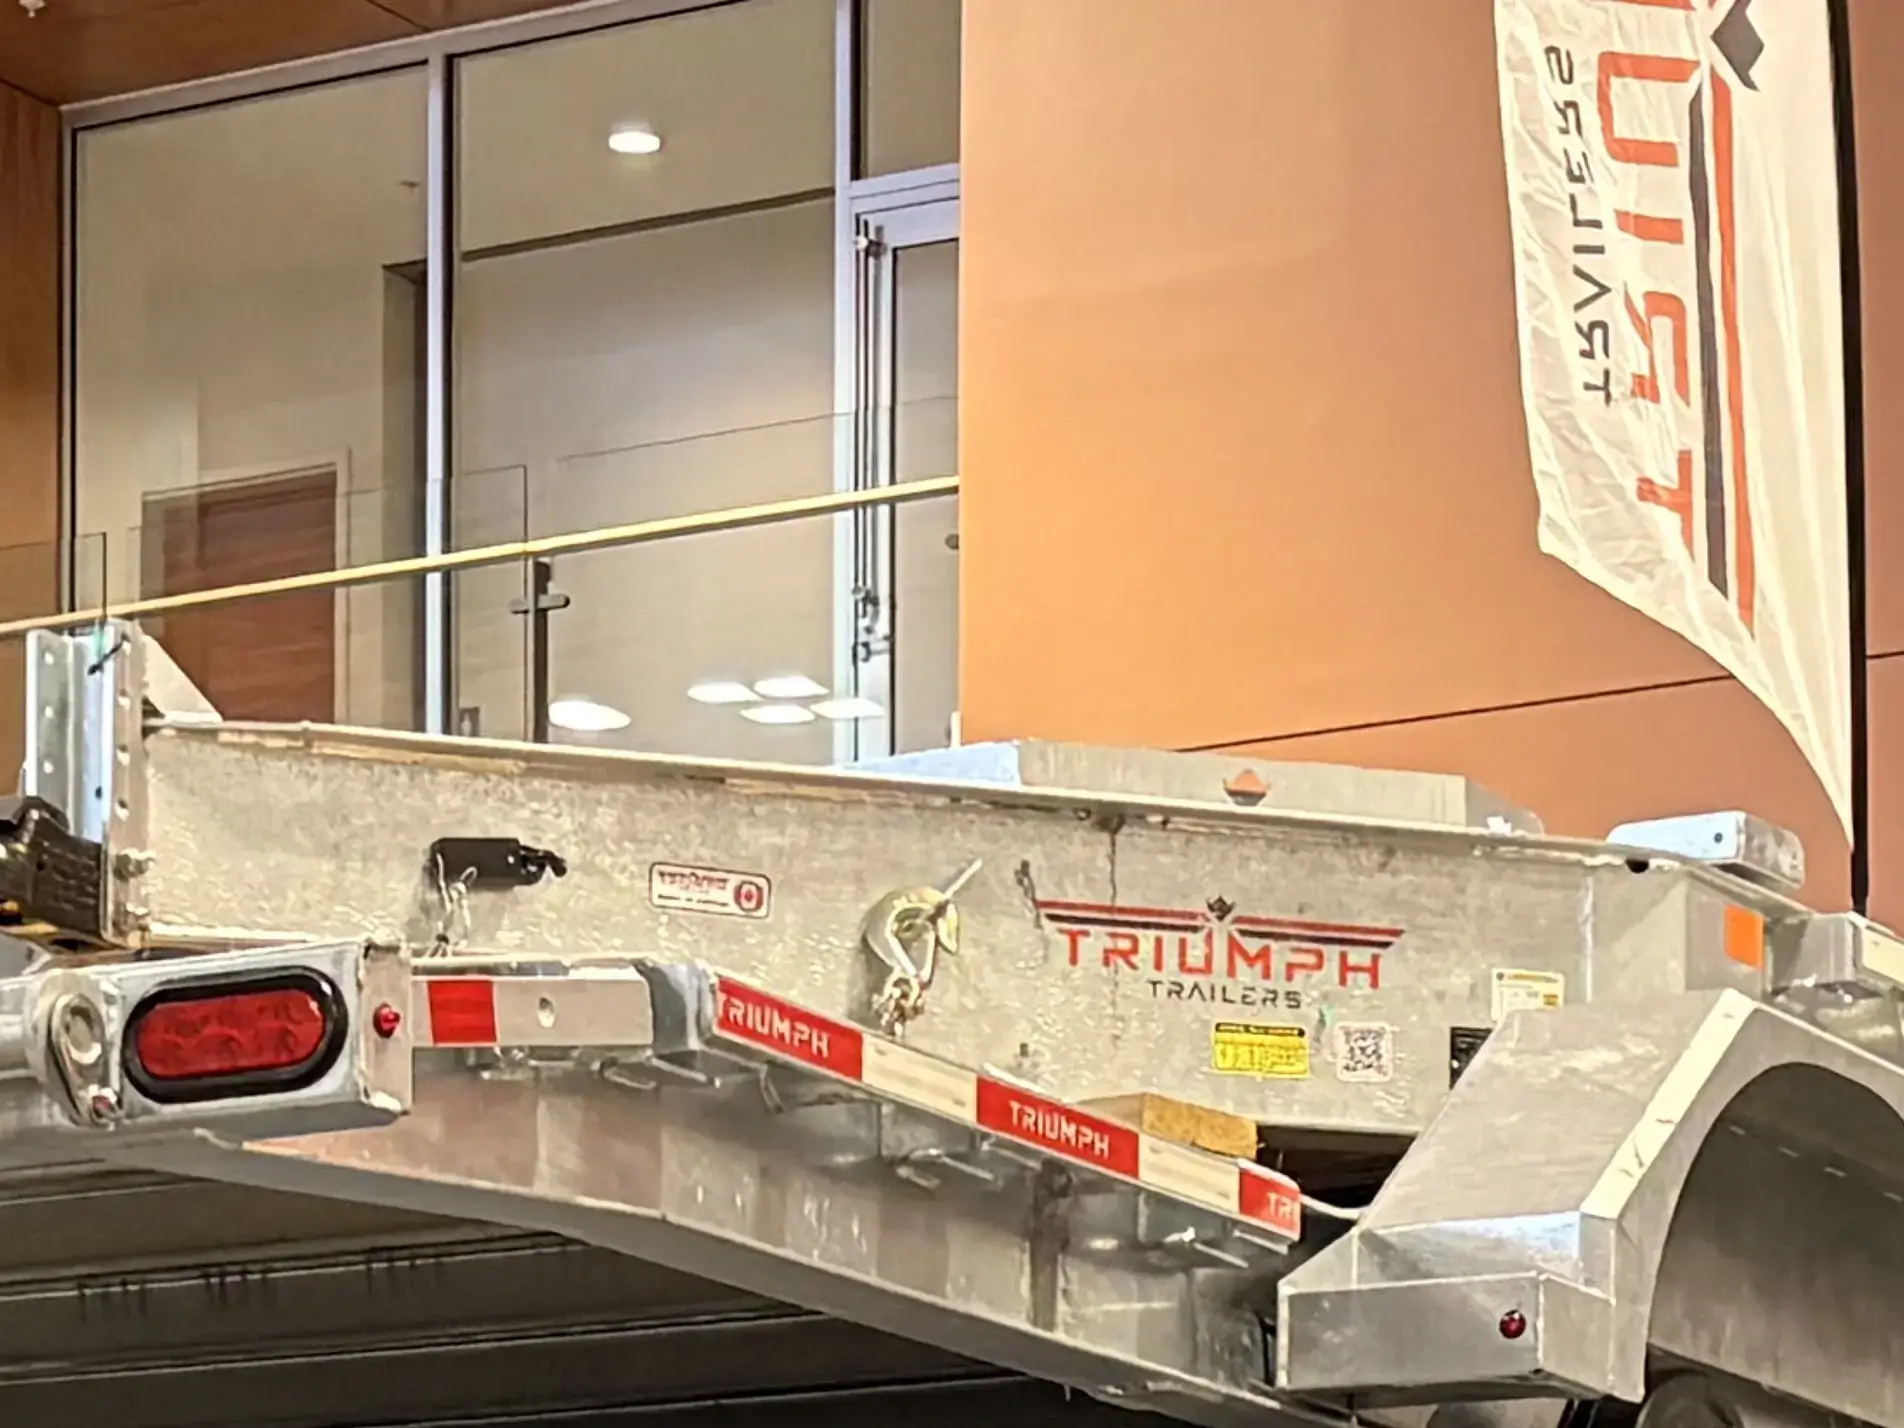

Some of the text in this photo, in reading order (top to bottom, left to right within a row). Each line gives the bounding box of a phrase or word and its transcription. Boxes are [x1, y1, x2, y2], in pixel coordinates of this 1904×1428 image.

[1062, 927, 1383, 990] TRIUMPH
[1148, 980, 1302, 1009] TRAILERS
[716, 990, 830, 1060] TRIUMPH
[1008, 1099, 1110, 1159] TRIUMPH
